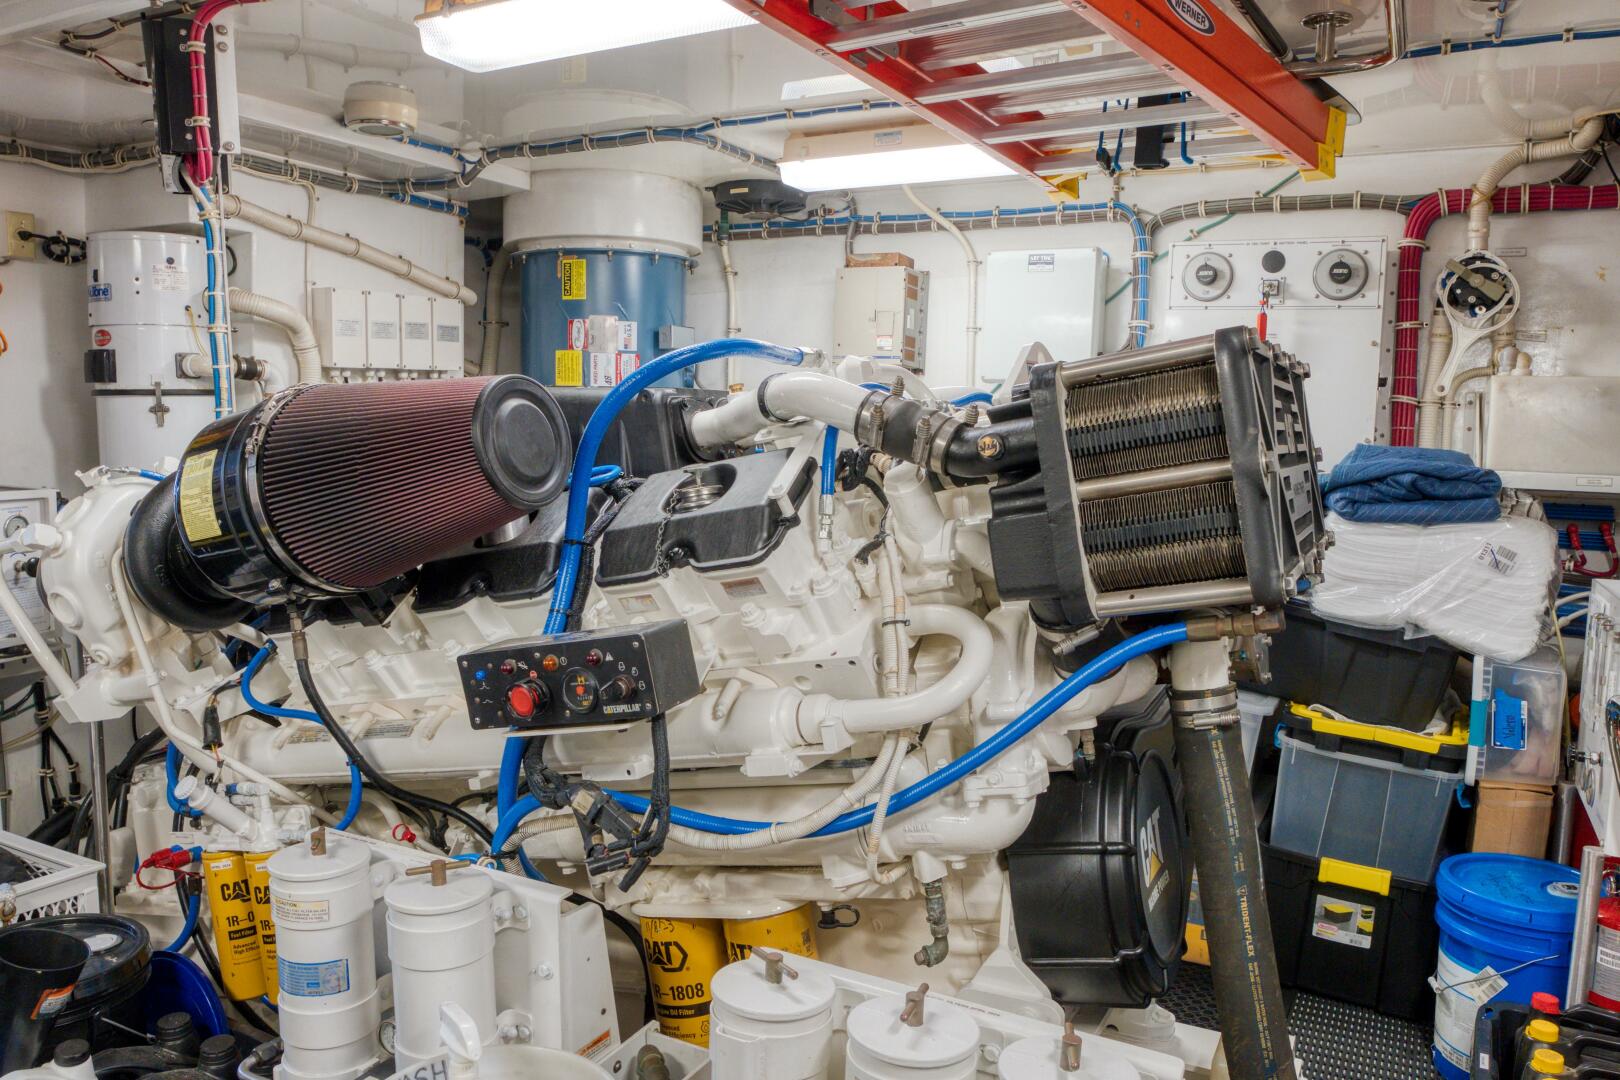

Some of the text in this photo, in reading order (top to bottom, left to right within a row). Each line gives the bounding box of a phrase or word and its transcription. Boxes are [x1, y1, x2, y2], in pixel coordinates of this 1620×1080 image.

[603, 703, 641, 714] CATERPILLAR
[1140, 805, 1164, 888] CAT
[220, 879, 251, 903] CAT
[230, 929, 255, 939] Fuel Filter
[1240, 896, 1255, 957] TRIDENT-FLEX
